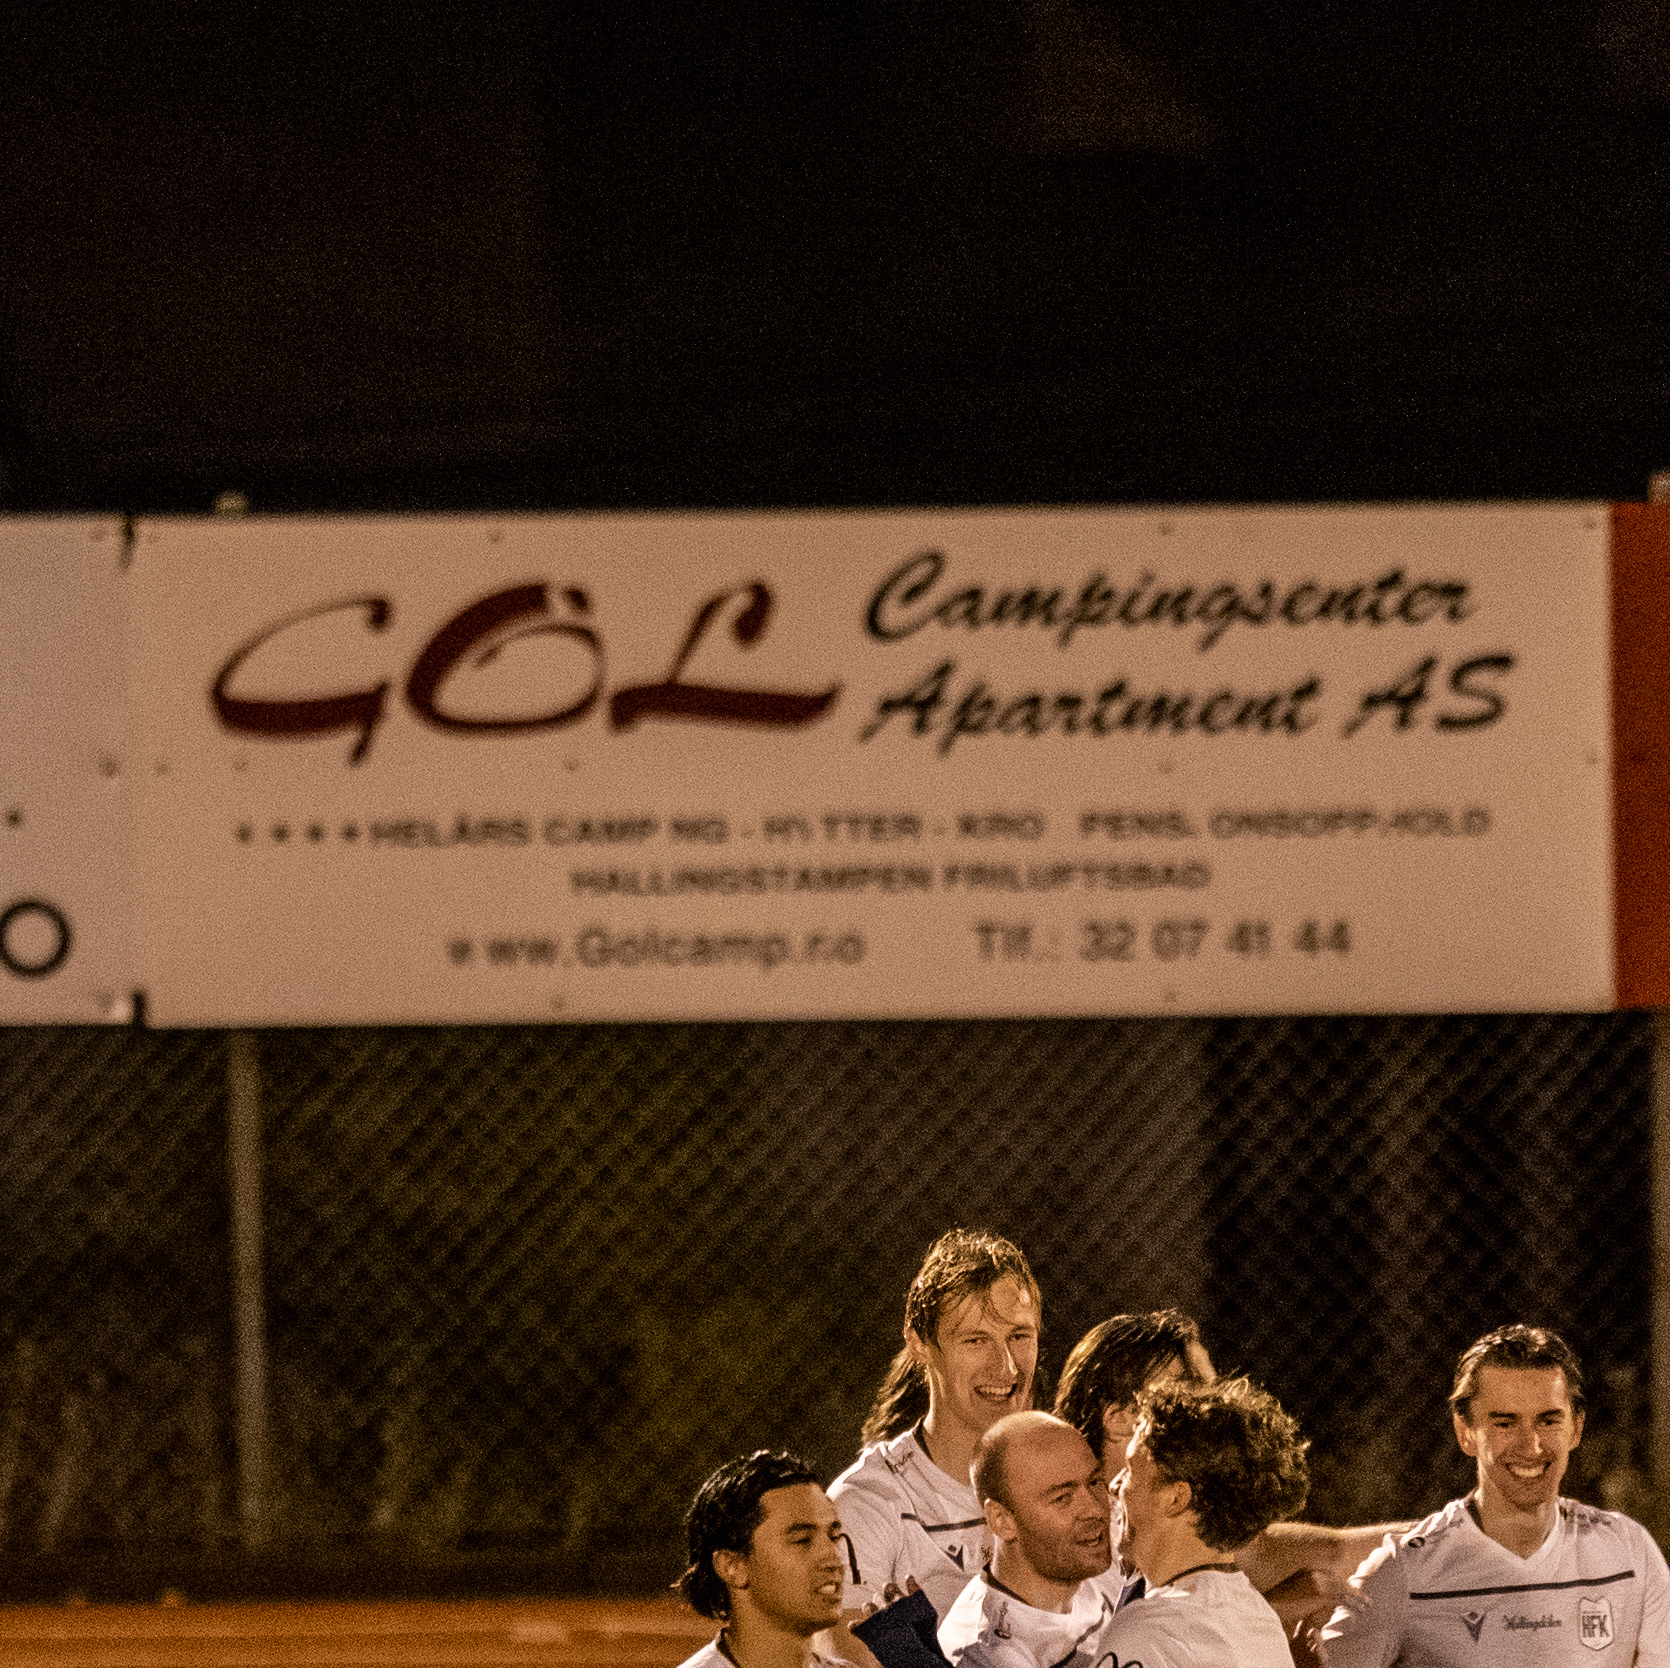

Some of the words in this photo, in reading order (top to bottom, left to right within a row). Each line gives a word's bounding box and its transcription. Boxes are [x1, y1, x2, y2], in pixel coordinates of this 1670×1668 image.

[861, 548, 1473, 652] Campingsenter
[208, 578, 843, 767] GOL
[857, 657, 1324, 756] Apartment
[1342, 650, 1518, 738] AS
[955, 809, 1047, 842] KRO
[1079, 917, 1139, 964] 32
[1149, 915, 1213, 963] 07
[1223, 917, 1273, 960] 41
[1290, 916, 1354, 959] 44
